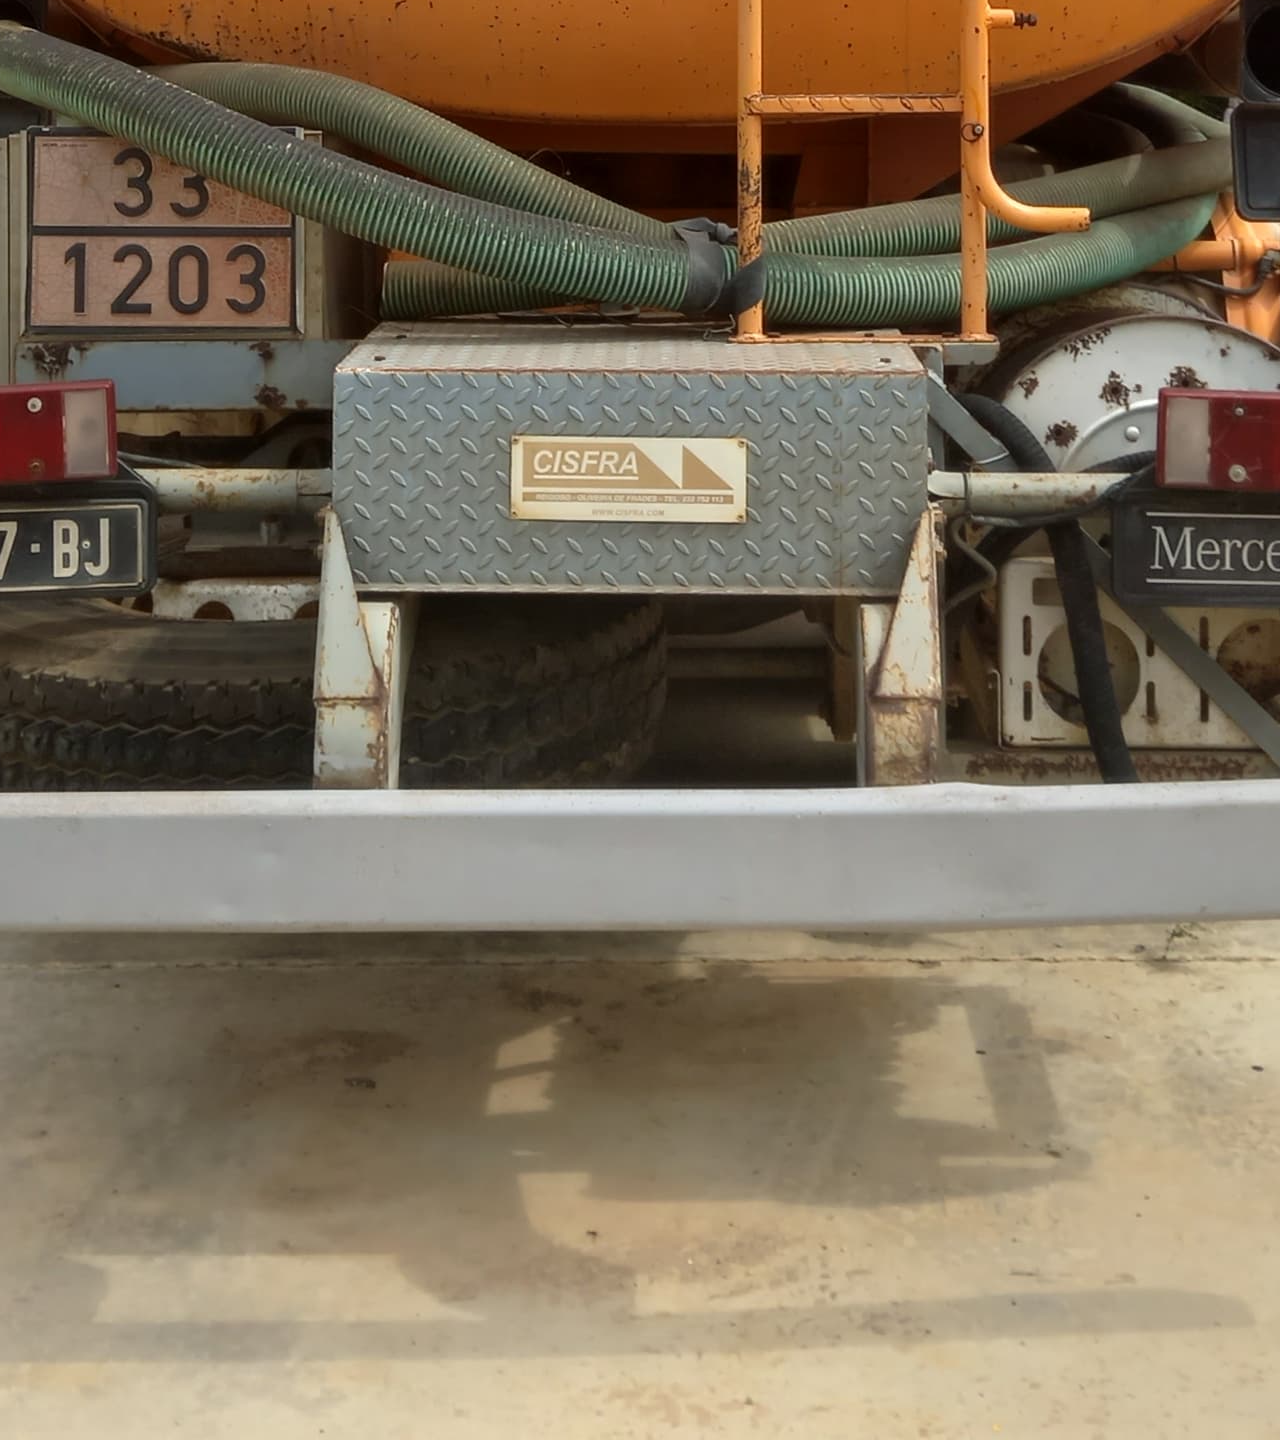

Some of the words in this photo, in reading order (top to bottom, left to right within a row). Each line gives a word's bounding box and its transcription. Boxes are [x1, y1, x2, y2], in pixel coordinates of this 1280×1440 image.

[113, 147, 209, 217] 33
[63, 242, 266, 314] 1203
[532, 450, 639, 474] CISFRA
